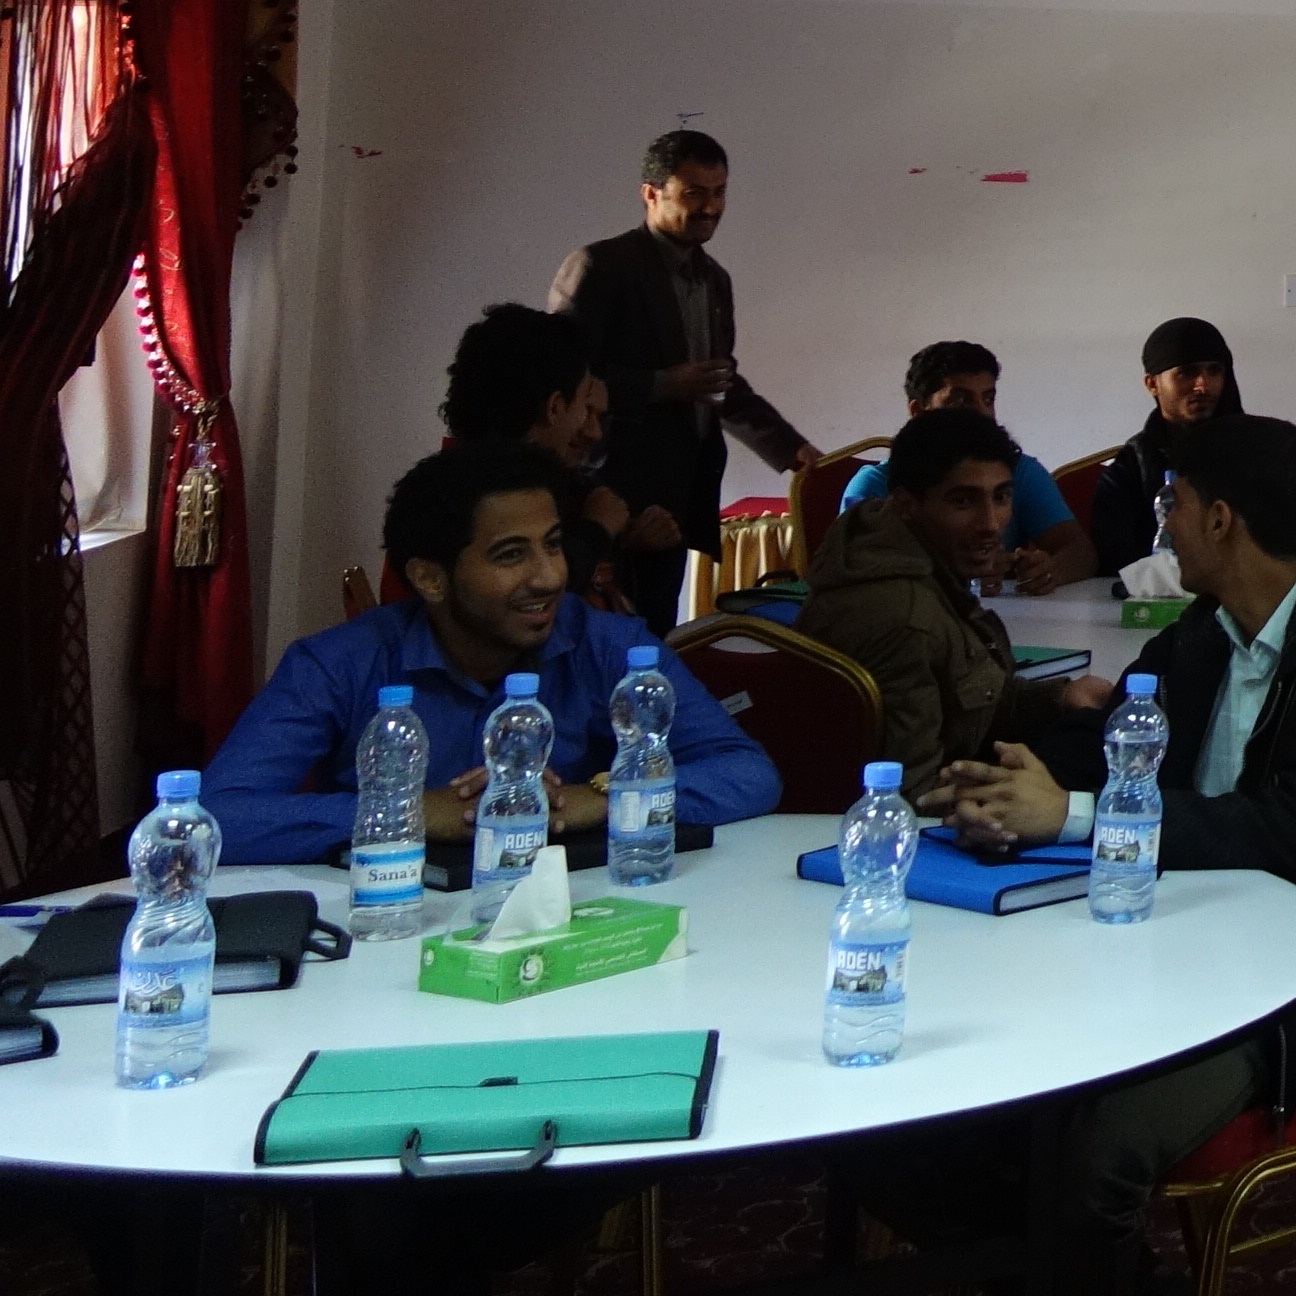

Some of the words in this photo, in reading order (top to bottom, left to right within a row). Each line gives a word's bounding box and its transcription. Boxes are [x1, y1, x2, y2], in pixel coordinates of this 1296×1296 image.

[505, 830, 544, 850] ADEN
[1101, 826, 1136, 845] ADEN
[368, 864, 419, 882] Sana'a
[837, 951, 881, 971] ADEN
